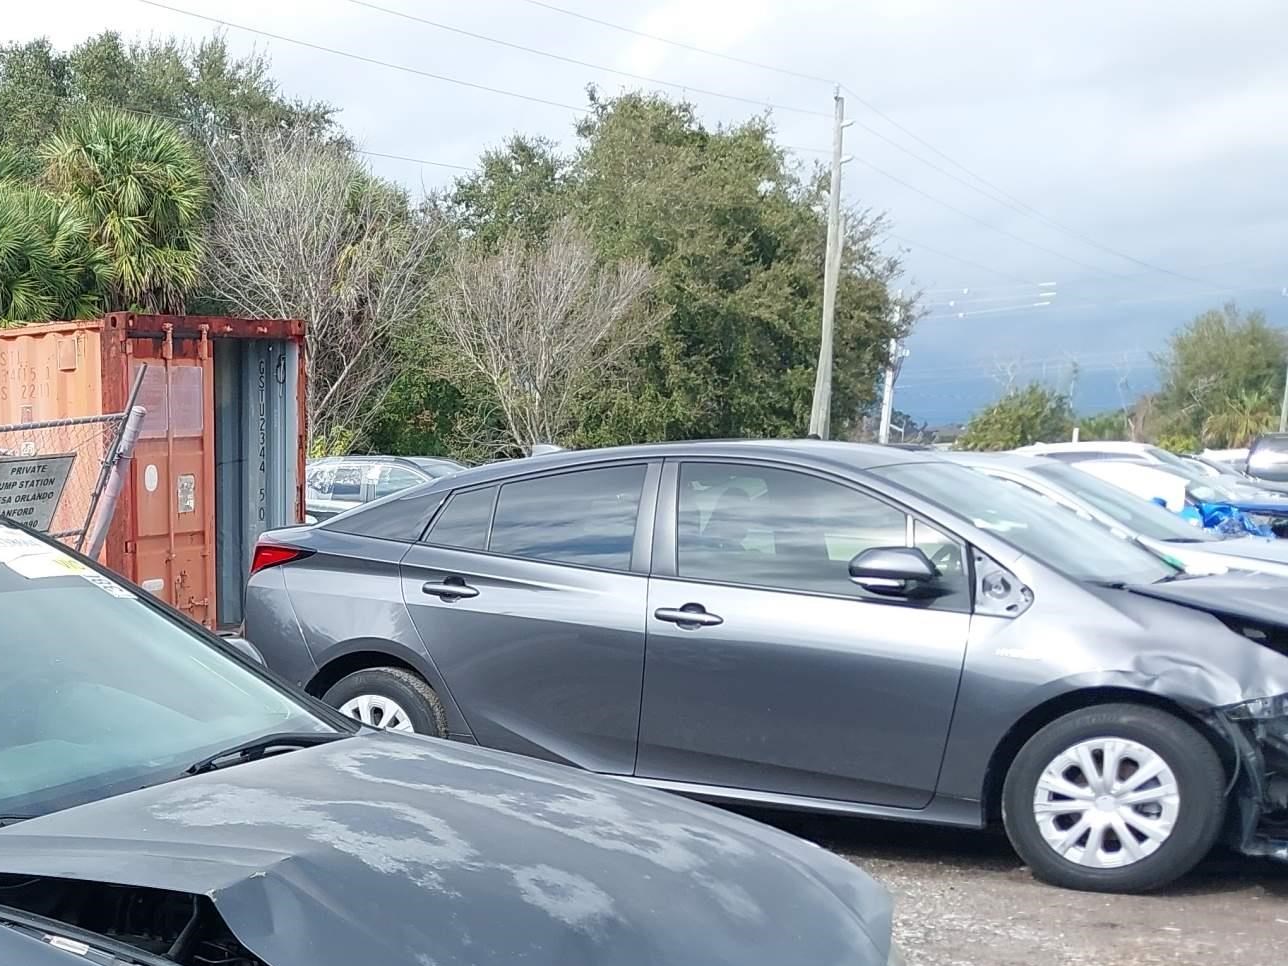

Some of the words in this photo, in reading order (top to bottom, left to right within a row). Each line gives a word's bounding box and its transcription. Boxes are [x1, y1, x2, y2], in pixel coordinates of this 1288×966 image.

[10, 464, 48, 475] PRIVATE
[18, 478, 55, 489] STATION
[14, 492, 54, 503] ORLANDO
